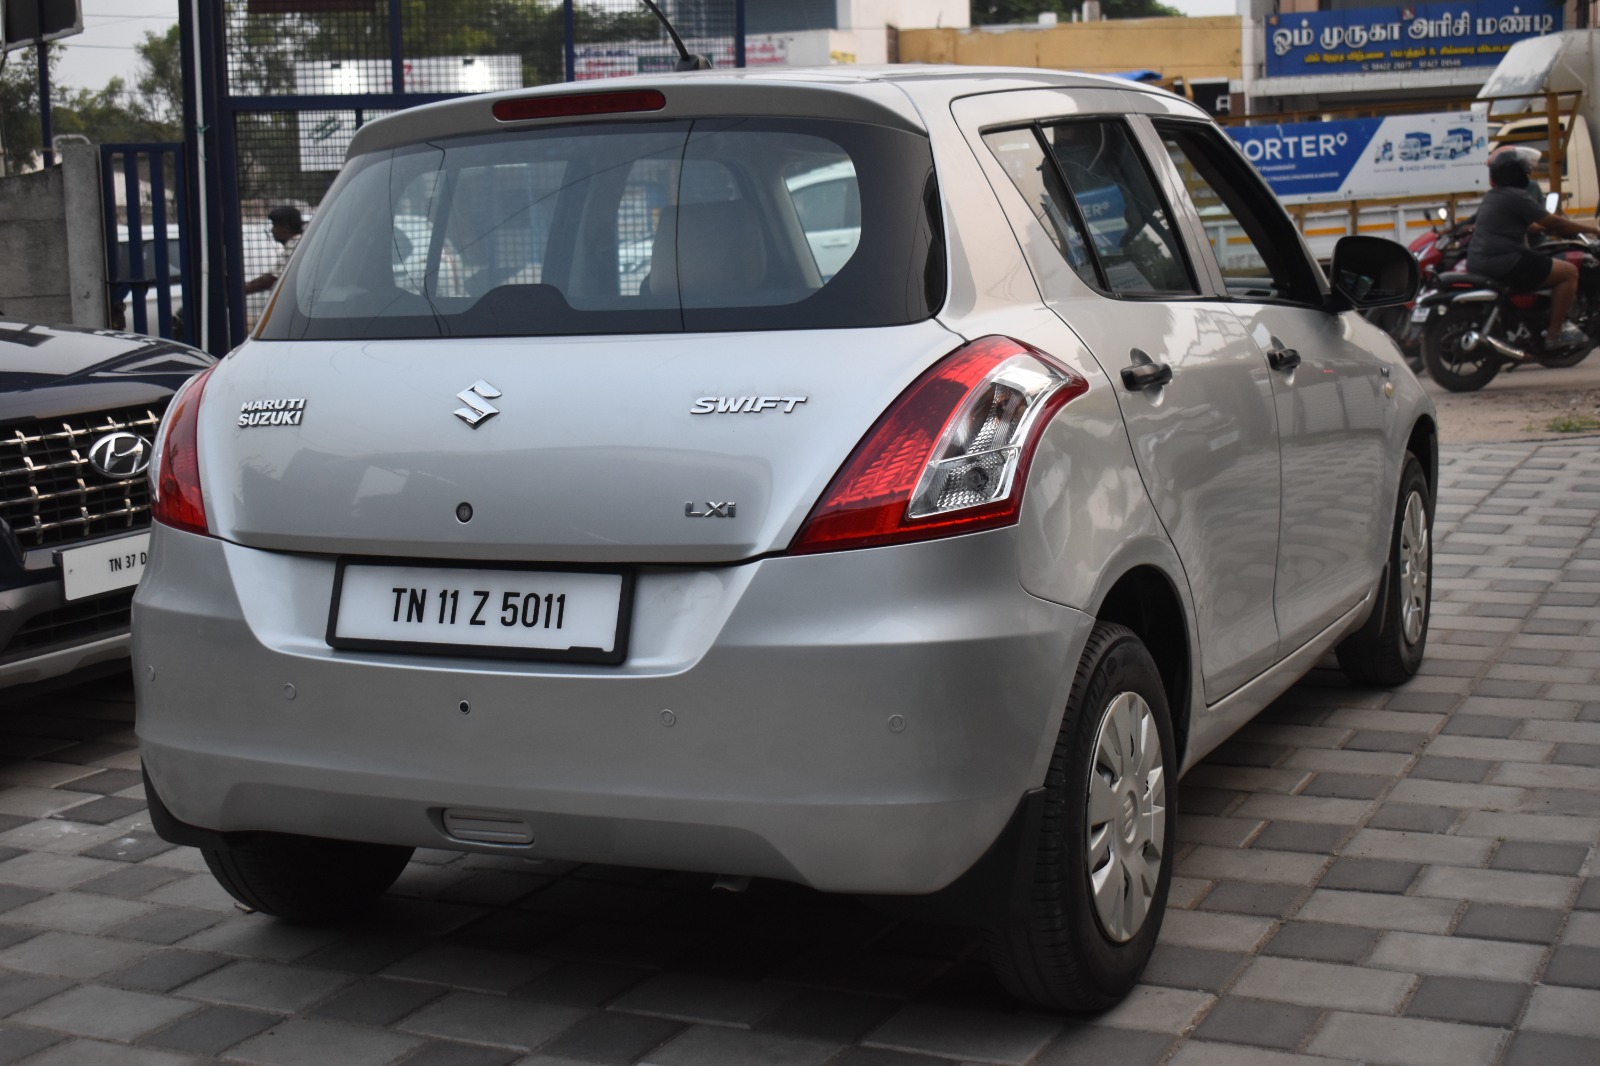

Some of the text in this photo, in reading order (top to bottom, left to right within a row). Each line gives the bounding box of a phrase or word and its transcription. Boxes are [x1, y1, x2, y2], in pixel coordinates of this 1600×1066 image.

[1273, 5, 1554, 56] ஓம் முருகா அரிசி மண்டி
[240, 398, 307, 412] MARUTI
[690, 395, 808, 414] SWIFT
[237, 411, 304, 428] SUZUKI
[684, 501, 736, 518] LXi
[109, 557, 122, 572] TN
[125, 554, 136, 568] 37
[392, 587, 567, 630] TN 11 Z 5011
